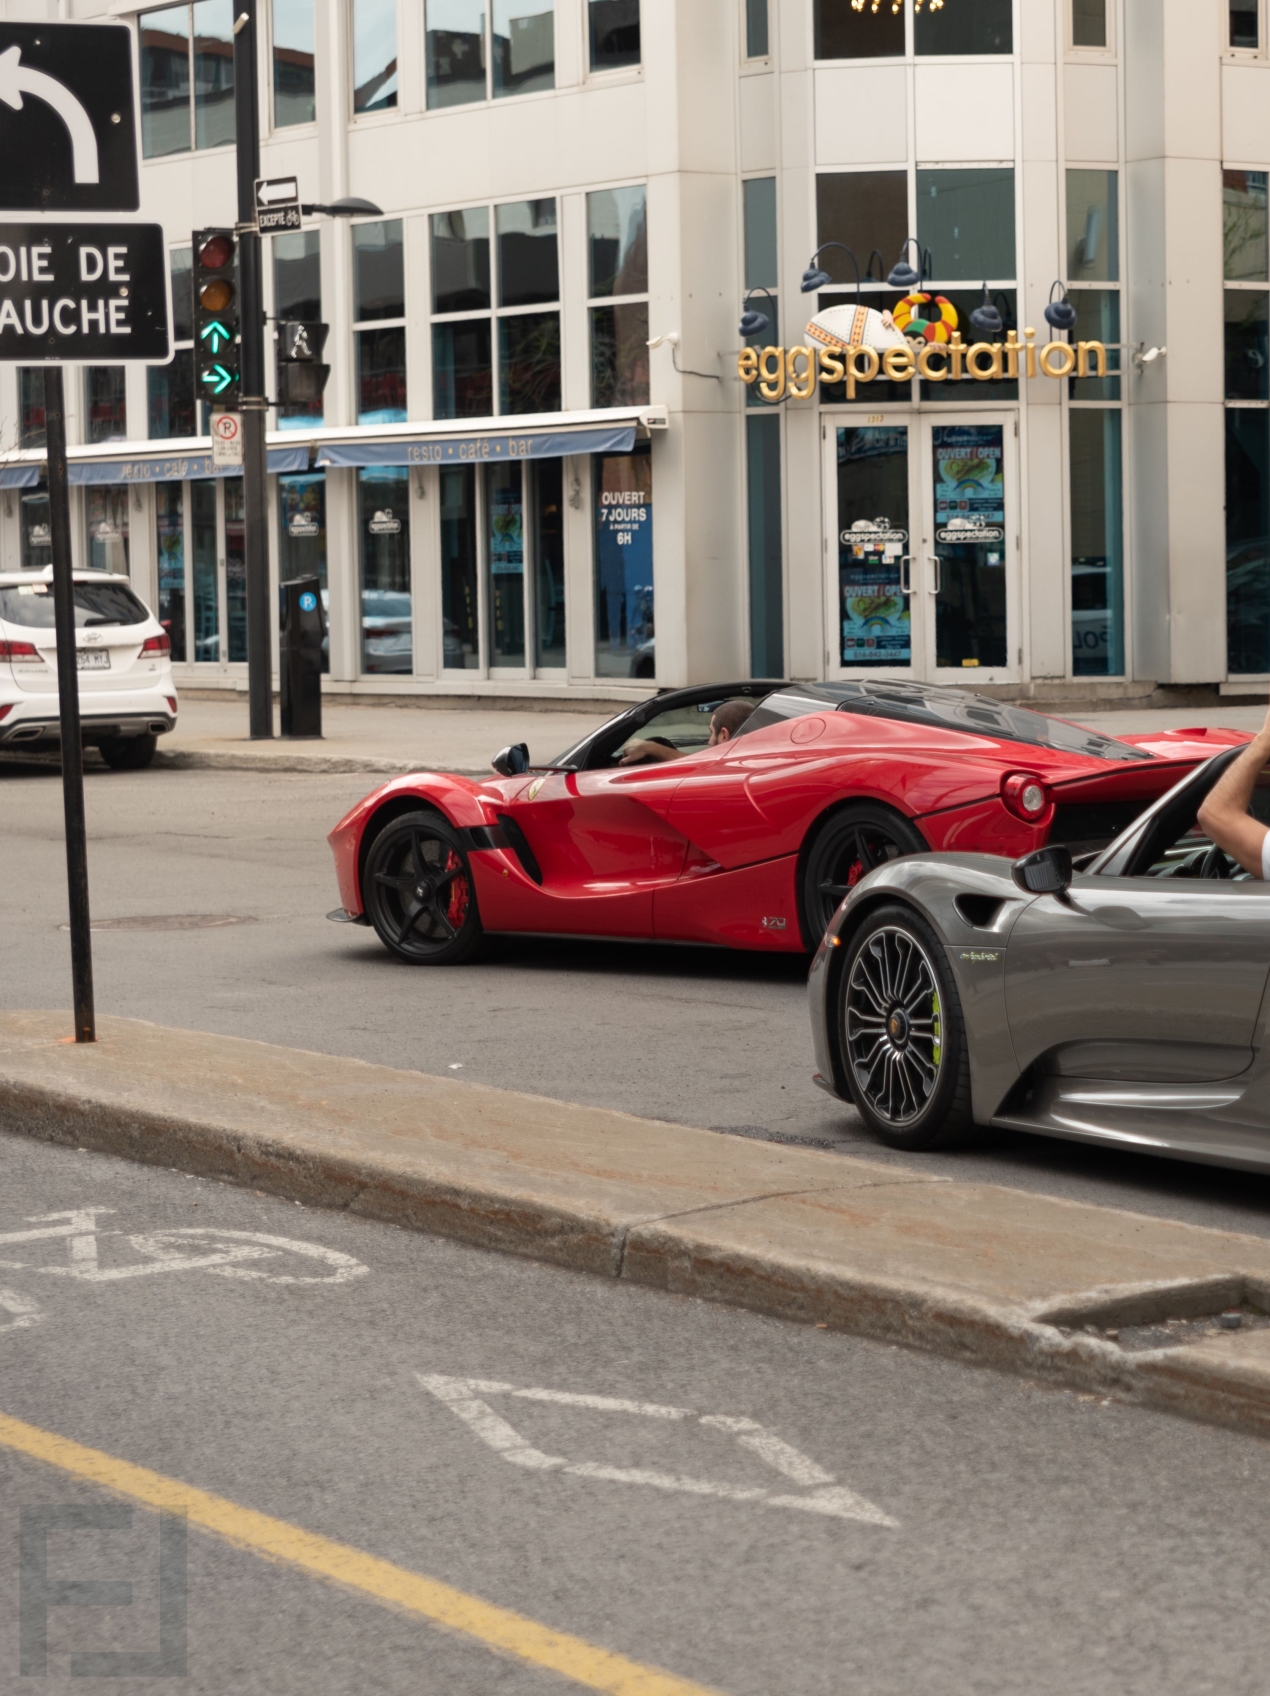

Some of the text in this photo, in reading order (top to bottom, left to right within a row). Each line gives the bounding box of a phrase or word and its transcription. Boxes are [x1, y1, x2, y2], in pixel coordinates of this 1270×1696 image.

[79, 246, 130, 281] DE
[737, 327, 1107, 399] eggspectation
[407, 437, 533, 461] resto café bar
[937, 448, 971, 460] OUVERT
[978, 447, 1001, 459] OPEN
[602, 491, 645, 505] OUVERT
[601, 507, 647, 521] 7 JOURS
[617, 531, 632, 545] 6H
[844, 531, 903, 542] eggspectation
[844, 585, 879, 597] OUVERT
